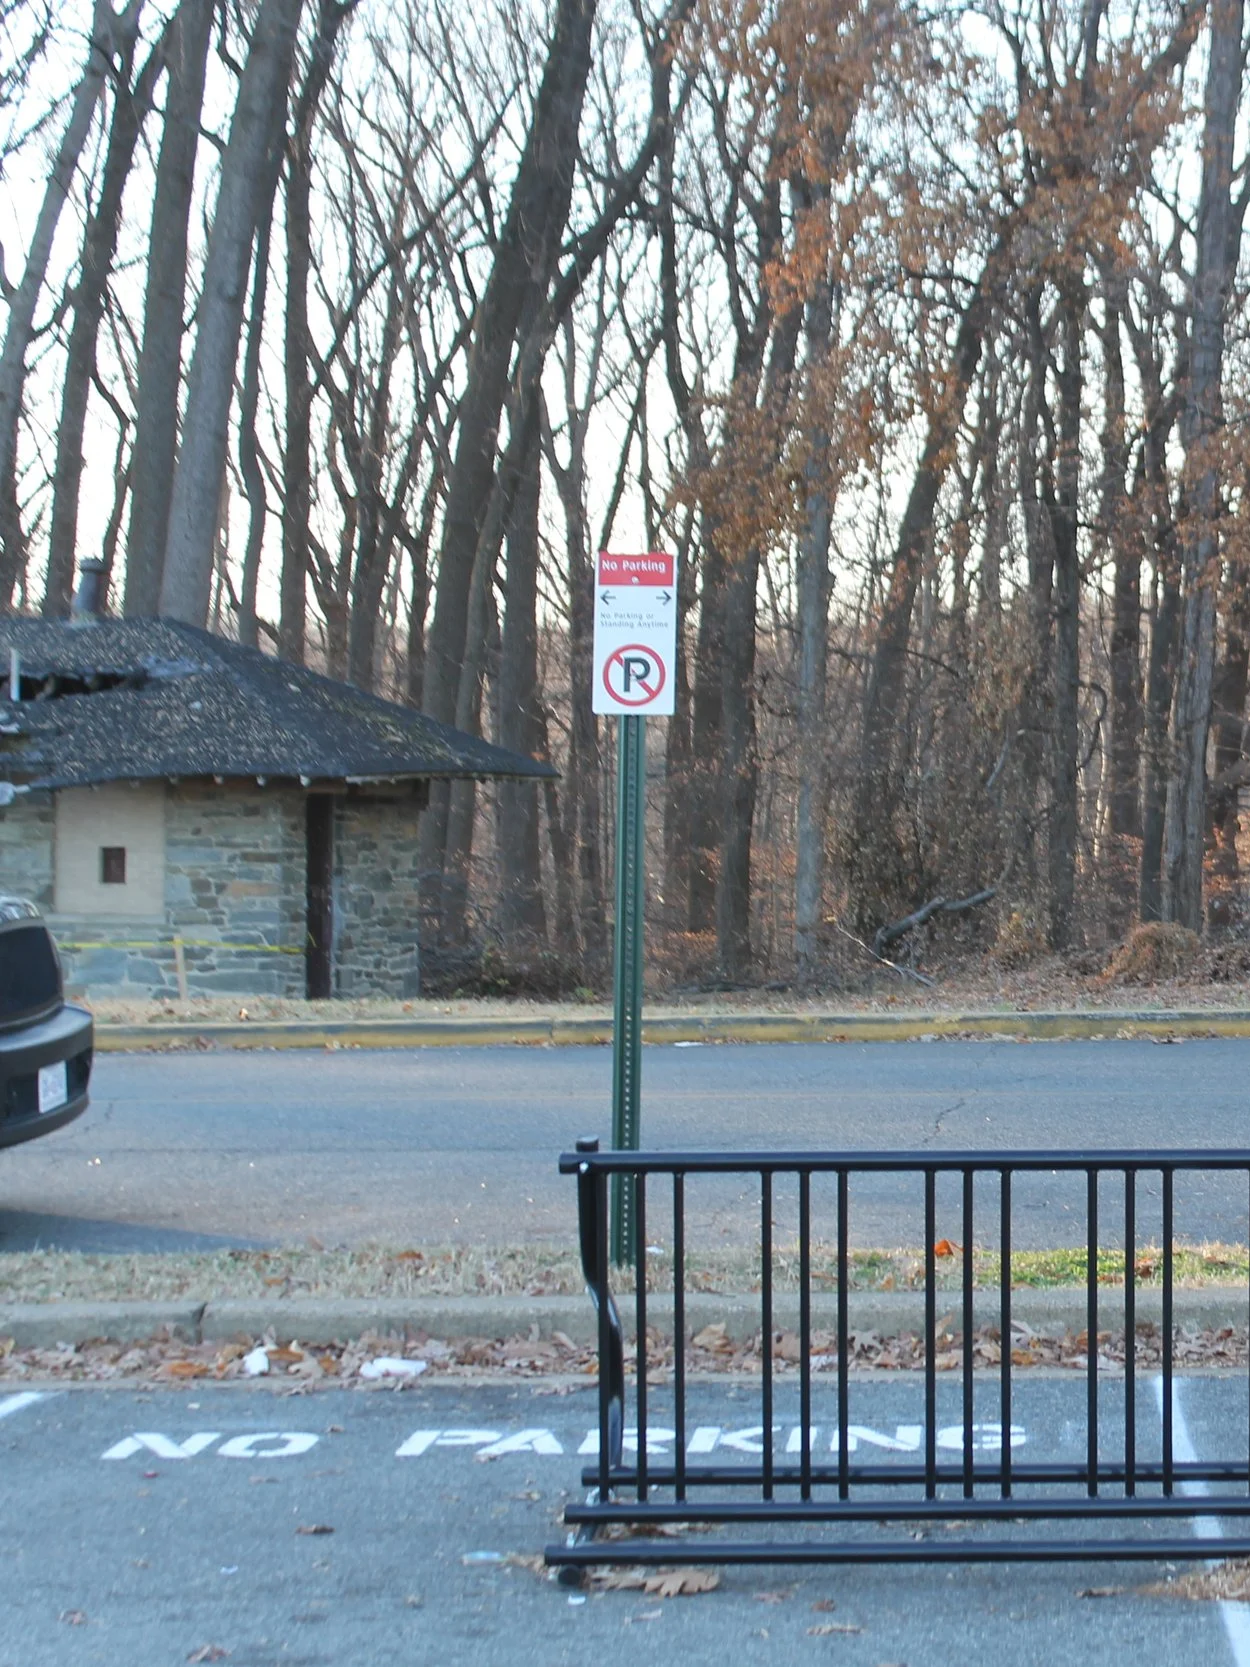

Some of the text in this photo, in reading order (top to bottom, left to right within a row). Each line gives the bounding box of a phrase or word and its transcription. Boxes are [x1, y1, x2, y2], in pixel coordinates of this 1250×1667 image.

[601, 560, 666, 574] No Parking
[600, 611, 611, 619] No
[614, 611, 643, 620] Parking
[600, 620, 635, 629] Standing
[623, 656, 651, 693] P
[100, 1424, 1027, 1460] NO PARKING
